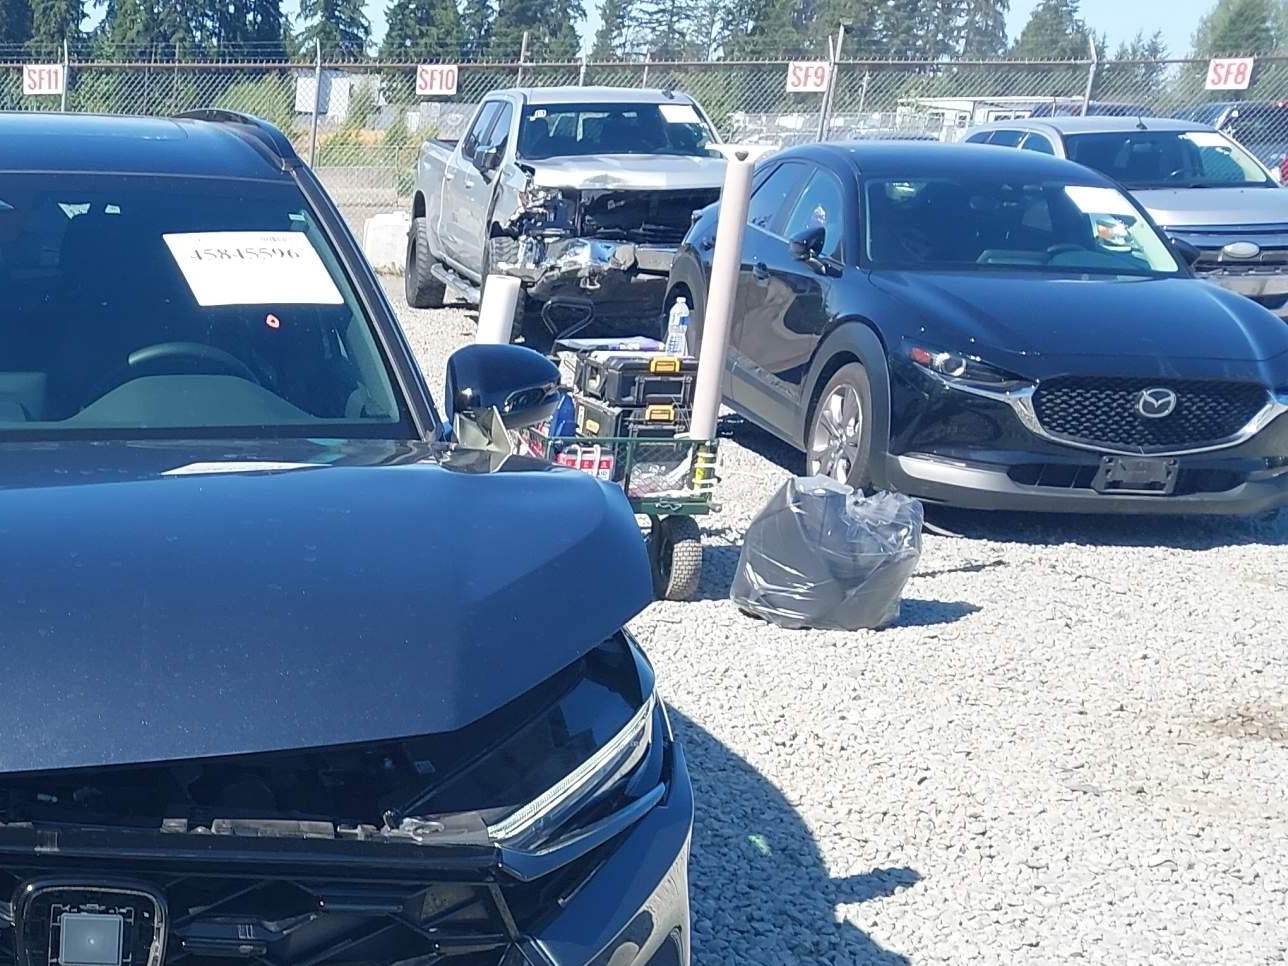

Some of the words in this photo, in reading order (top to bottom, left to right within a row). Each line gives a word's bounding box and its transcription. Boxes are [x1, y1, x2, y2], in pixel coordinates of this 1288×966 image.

[27, 68, 59, 90] SF11
[419, 68, 456, 91] SF10
[791, 65, 825, 87] SF9
[1211, 62, 1248, 85] SF8
